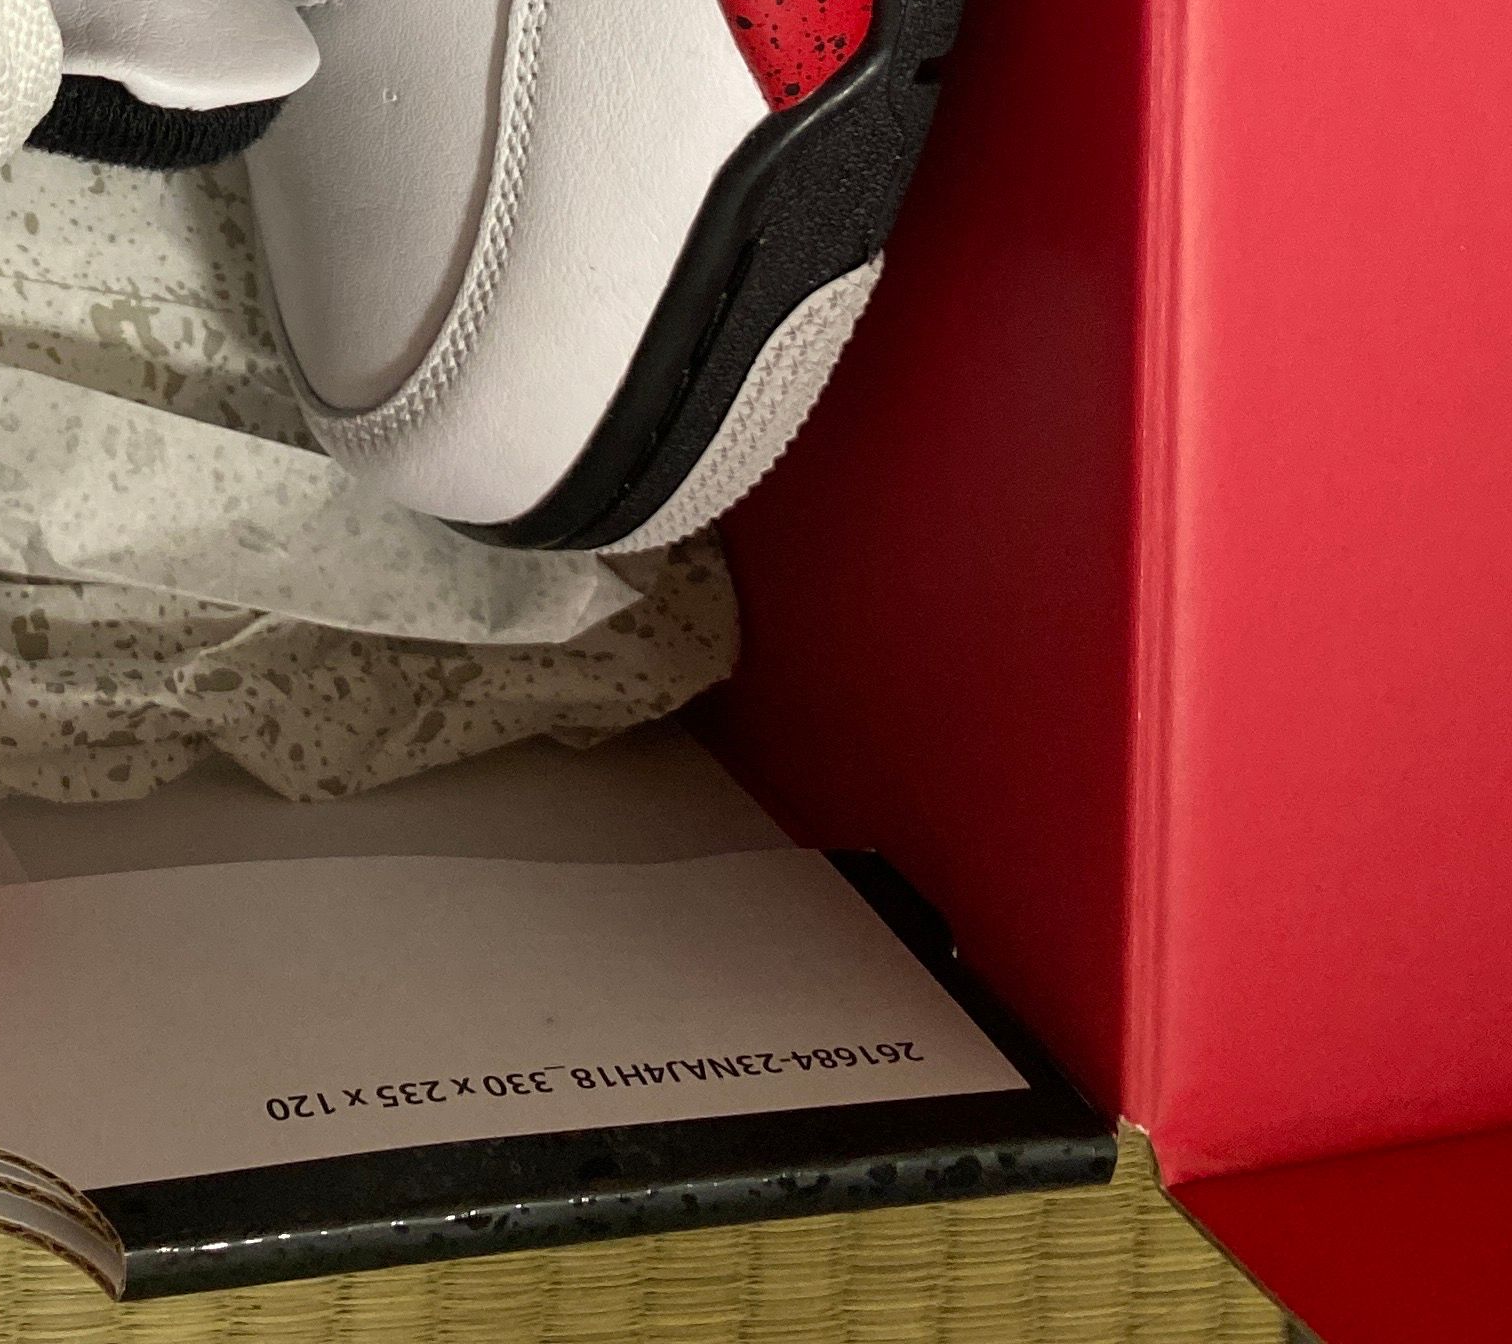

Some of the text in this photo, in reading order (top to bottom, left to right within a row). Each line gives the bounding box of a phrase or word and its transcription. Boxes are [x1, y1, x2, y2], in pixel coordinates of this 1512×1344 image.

[265, 1041, 926, 1122] 261684-23NAJ4H18_330 x 235 x 120
